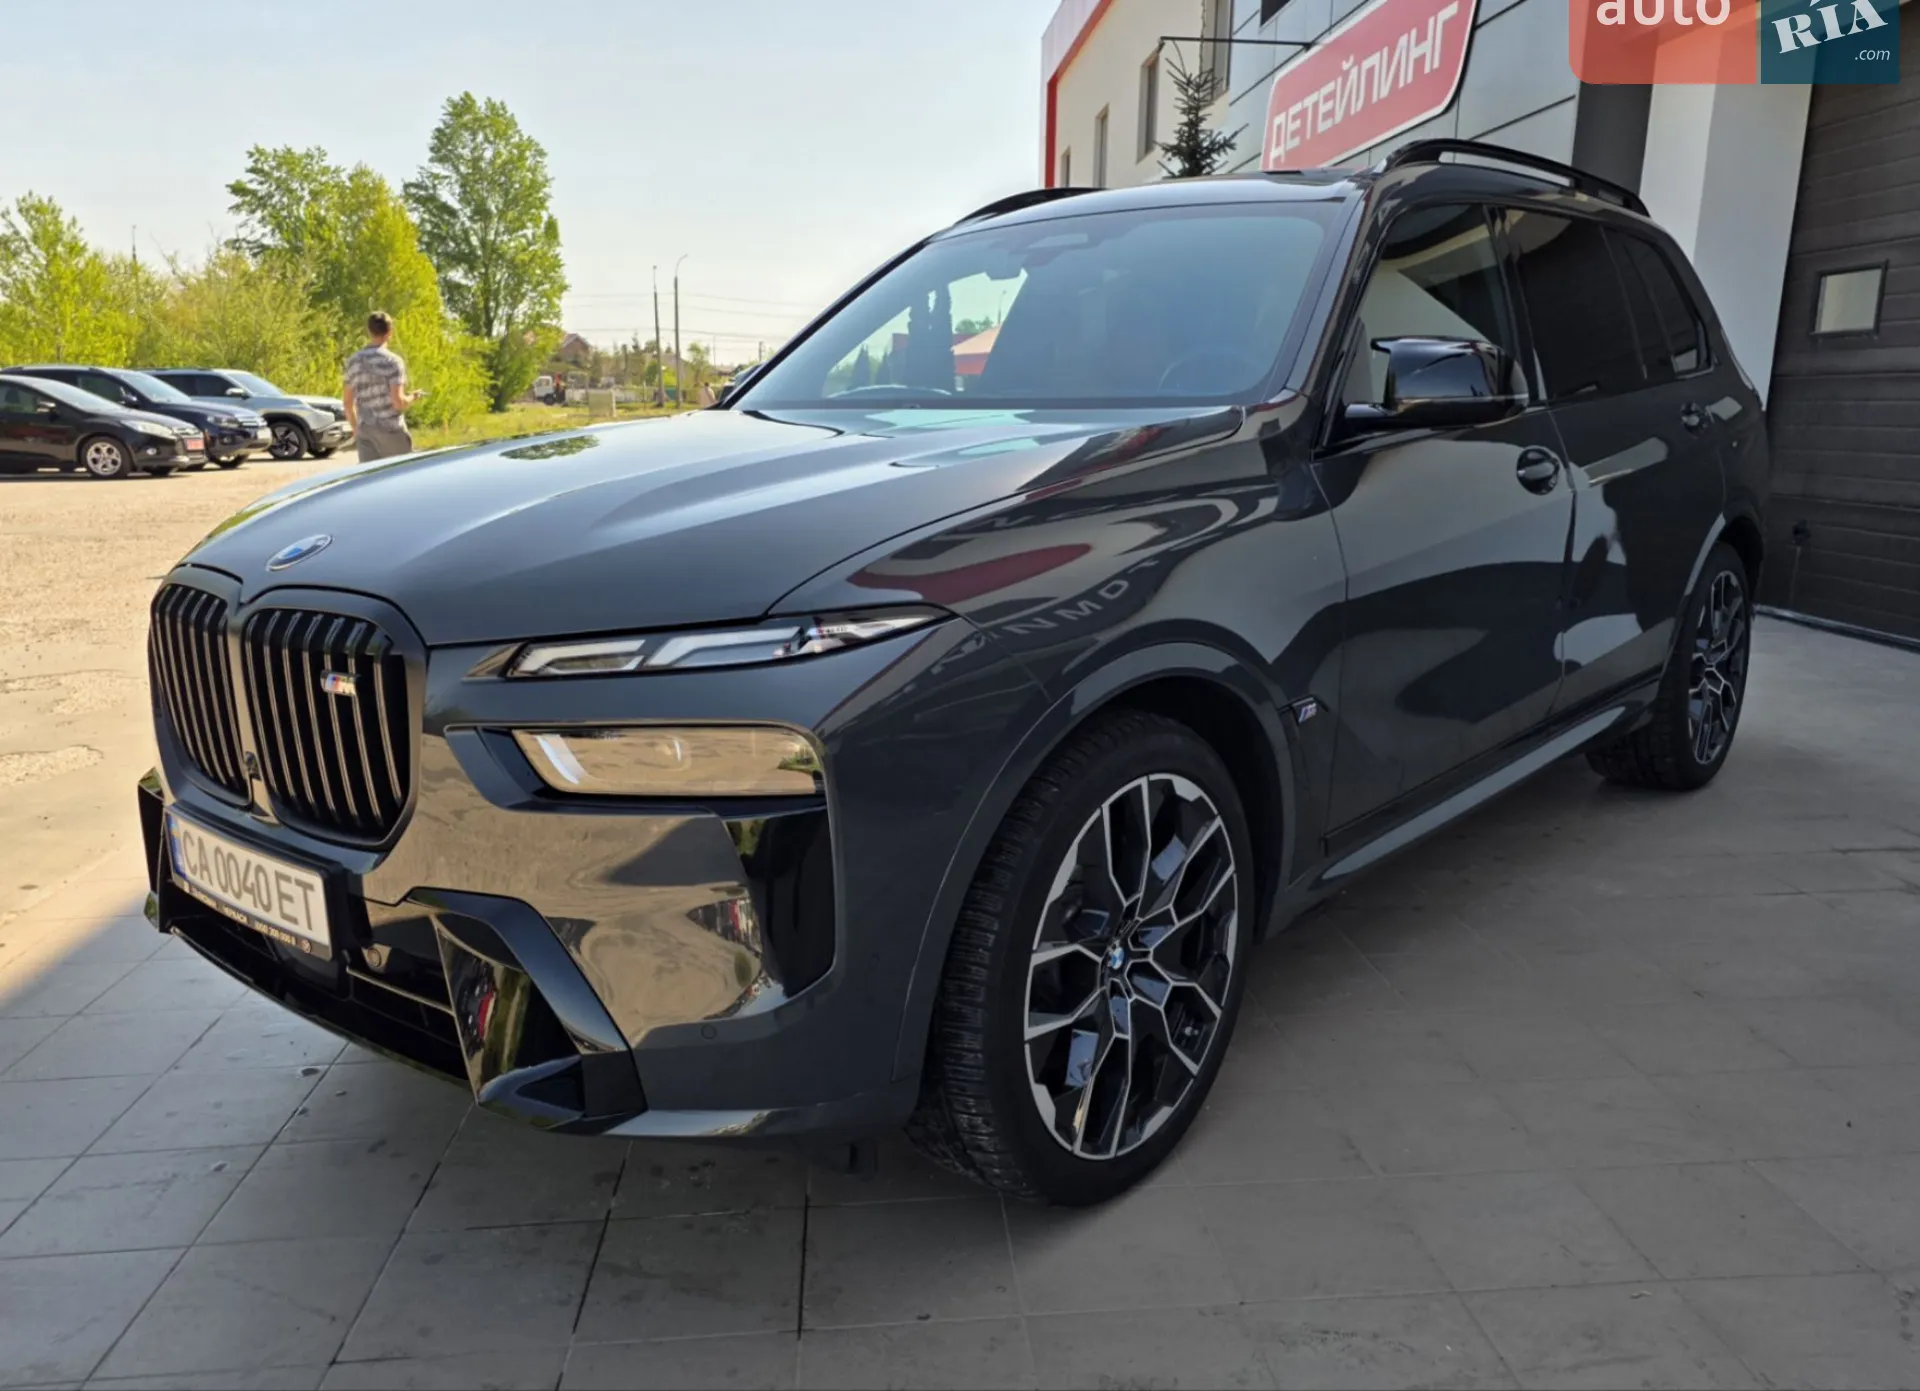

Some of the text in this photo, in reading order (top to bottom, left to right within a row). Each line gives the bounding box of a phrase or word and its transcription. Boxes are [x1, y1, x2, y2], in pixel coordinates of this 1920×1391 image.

[1269, 1, 1459, 169] ДЕТЕЙЛИНГ
[183, 830, 213, 886] CA
[214, 845, 272, 913] 0040
[274, 869, 315, 931] ET
